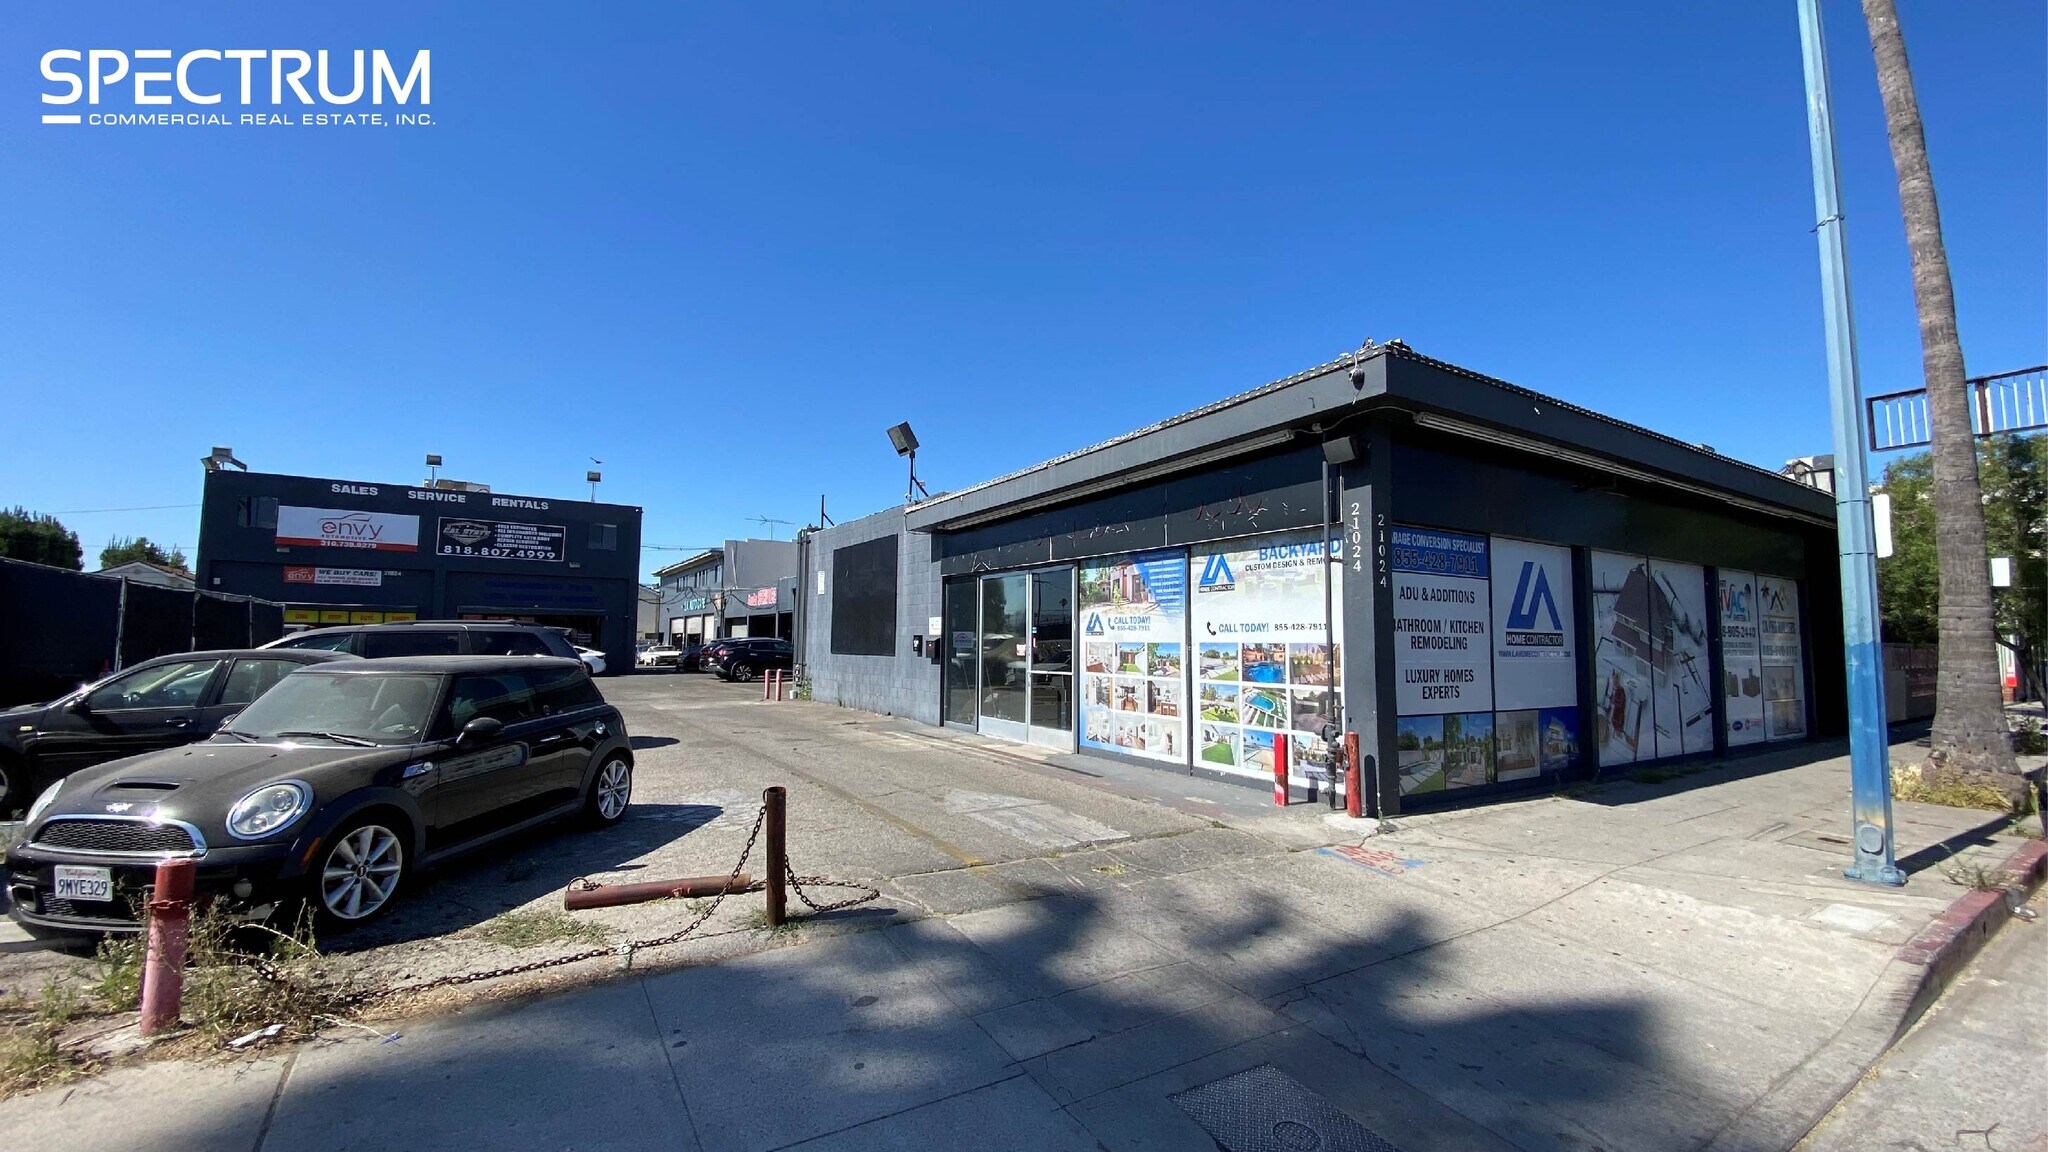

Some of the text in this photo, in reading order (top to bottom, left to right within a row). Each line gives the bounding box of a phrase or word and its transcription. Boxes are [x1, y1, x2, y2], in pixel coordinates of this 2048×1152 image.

[331, 483, 549, 510] SALES SERVICE RENTALS
[322, 521, 383, 540] envy
[1351, 502, 1361, 572] 21024
[1378, 514, 1387, 588] 21024
[1412, 534, 1451, 550] CONVERSION
[1452, 539, 1485, 554] SPECIALIST
[443, 545, 556, 559] 818.807.4999
[1245, 563, 1272, 571] CUSTOM
[1273, 561, 1297, 569] DESIGN
[1393, 548, 1479, 573] 855-428-7911
[1399, 586, 1475, 604] ADU & ADDITIONS
[1114, 616, 1151, 625] CALL TODAY!
[1219, 623, 1327, 632] CALL TODAY! 855-428-7911
[1449, 620, 1484, 634] KITCHEN
[1411, 635, 1468, 650] REMODELING
[1507, 634, 1563, 645] HOME CONTRACTOR
[1405, 669, 1474, 683] LUXURY HOMES
[1422, 685, 1460, 699] EXPERTS
[58, 878, 108, 896] 9MYE329
